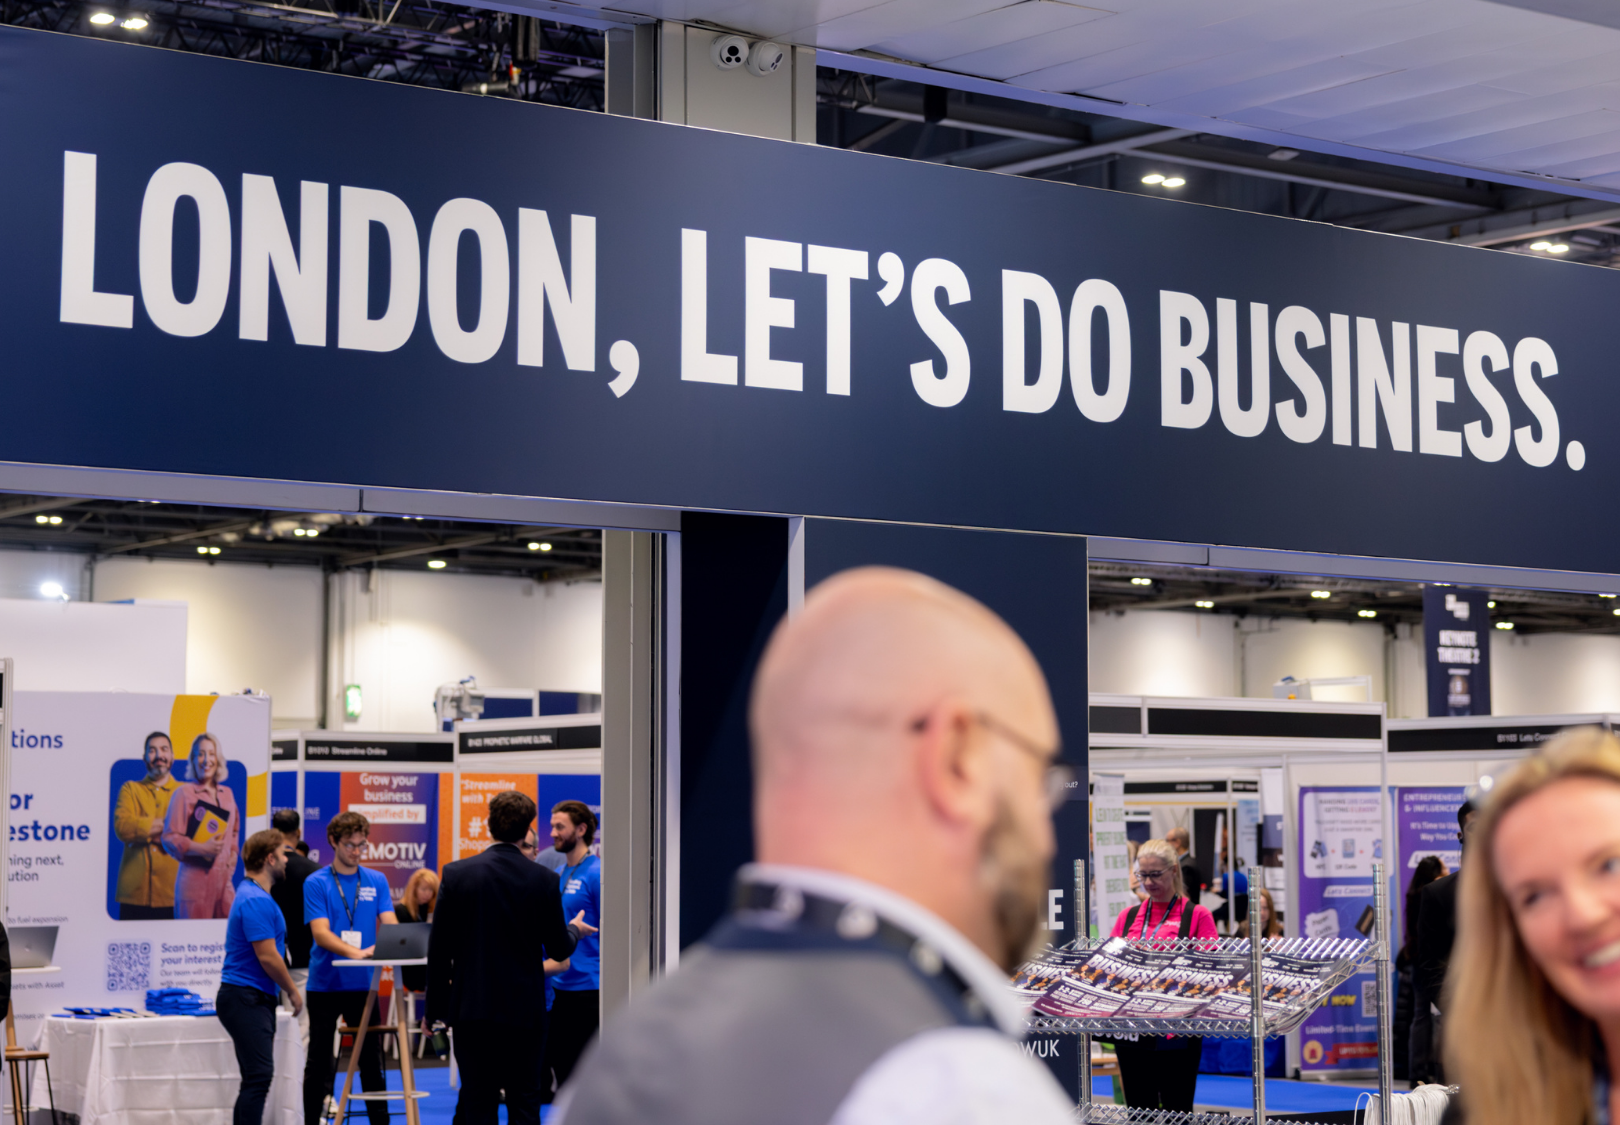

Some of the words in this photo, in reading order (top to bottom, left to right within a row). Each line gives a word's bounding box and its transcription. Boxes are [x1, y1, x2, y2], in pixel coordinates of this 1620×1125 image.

[60, 150, 640, 399] LONDON,
[681, 228, 972, 408] LET’S
[1002, 268, 1132, 423] DO
[1160, 290, 1586, 471] BUSINESS.
[359, 773, 390, 786] Grow
[392, 774, 418, 789] your
[364, 789, 413, 802] business
[462, 793, 483, 803] with
[360, 808, 404, 821] implified
[407, 808, 419, 821] by
[161, 943, 185, 953] Scan
[187, 943, 198, 952] to
[160, 957, 182, 968] your
[184, 955, 221, 965] interest
[1157, 967, 1234, 988] BUSINESS
